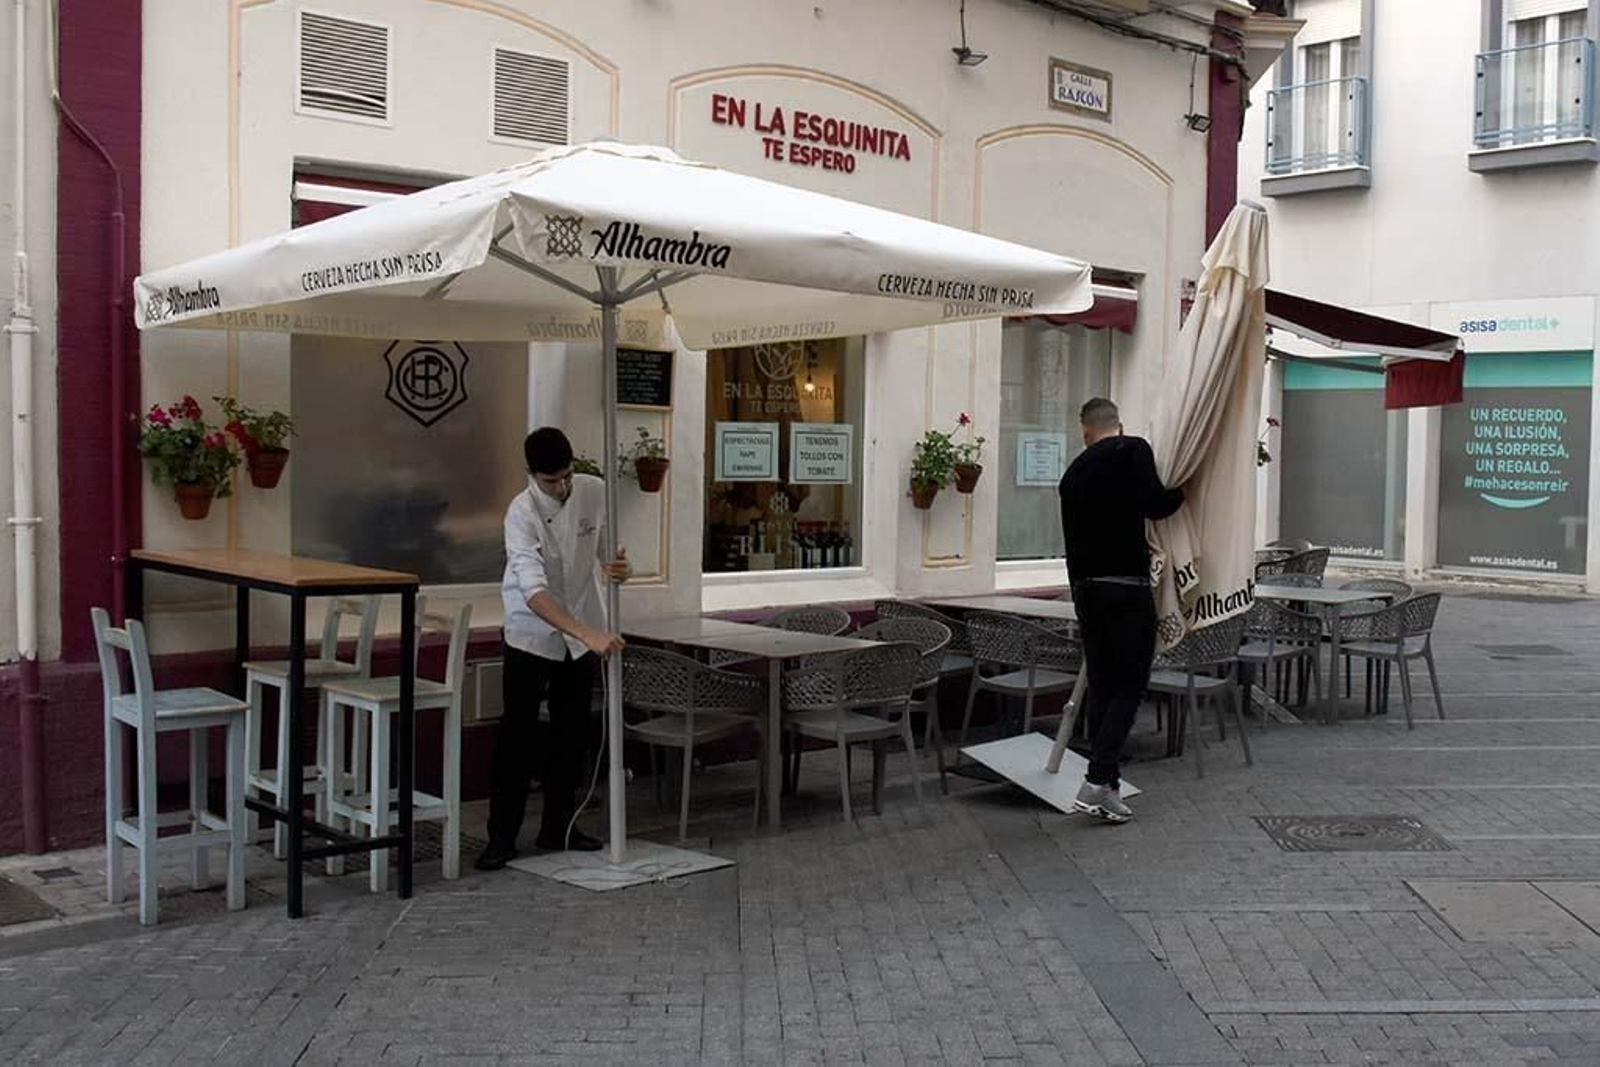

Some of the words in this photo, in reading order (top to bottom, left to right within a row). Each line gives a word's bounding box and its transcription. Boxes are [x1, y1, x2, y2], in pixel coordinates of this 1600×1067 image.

[711, 93, 746, 128] EN
[754, 102, 786, 136] LA
[793, 111, 911, 161] ESQUINITA
[762, 137, 785, 161] TE
[789, 143, 856, 174] ESPERO
[591, 221, 732, 269] Alhambra
[301, 265, 346, 292] CERVEZA
[345, 260, 381, 284] HECHA
[382, 255, 404, 278] SIN
[407, 251, 443, 275] PRISA
[163, 279, 221, 320] Alhambra
[877, 274, 933, 296] CERVEZA
[935, 280, 976, 300] HECHA
[978, 285, 999, 304] SIN
[1001, 288, 1035, 309] PRISA
[1470, 407, 1489, 421] UN
[1492, 408, 1567, 424] RECUERDO,
[1474, 425, 1502, 439] UNA
[1504, 422, 1562, 442] ILUSIÓN,
[1465, 442, 1493, 456] UNA
[1495, 442, 1570, 459] SORPRESA,
[1475, 459, 1494, 473] UN
[1497, 460, 1561, 475] REGALO...
